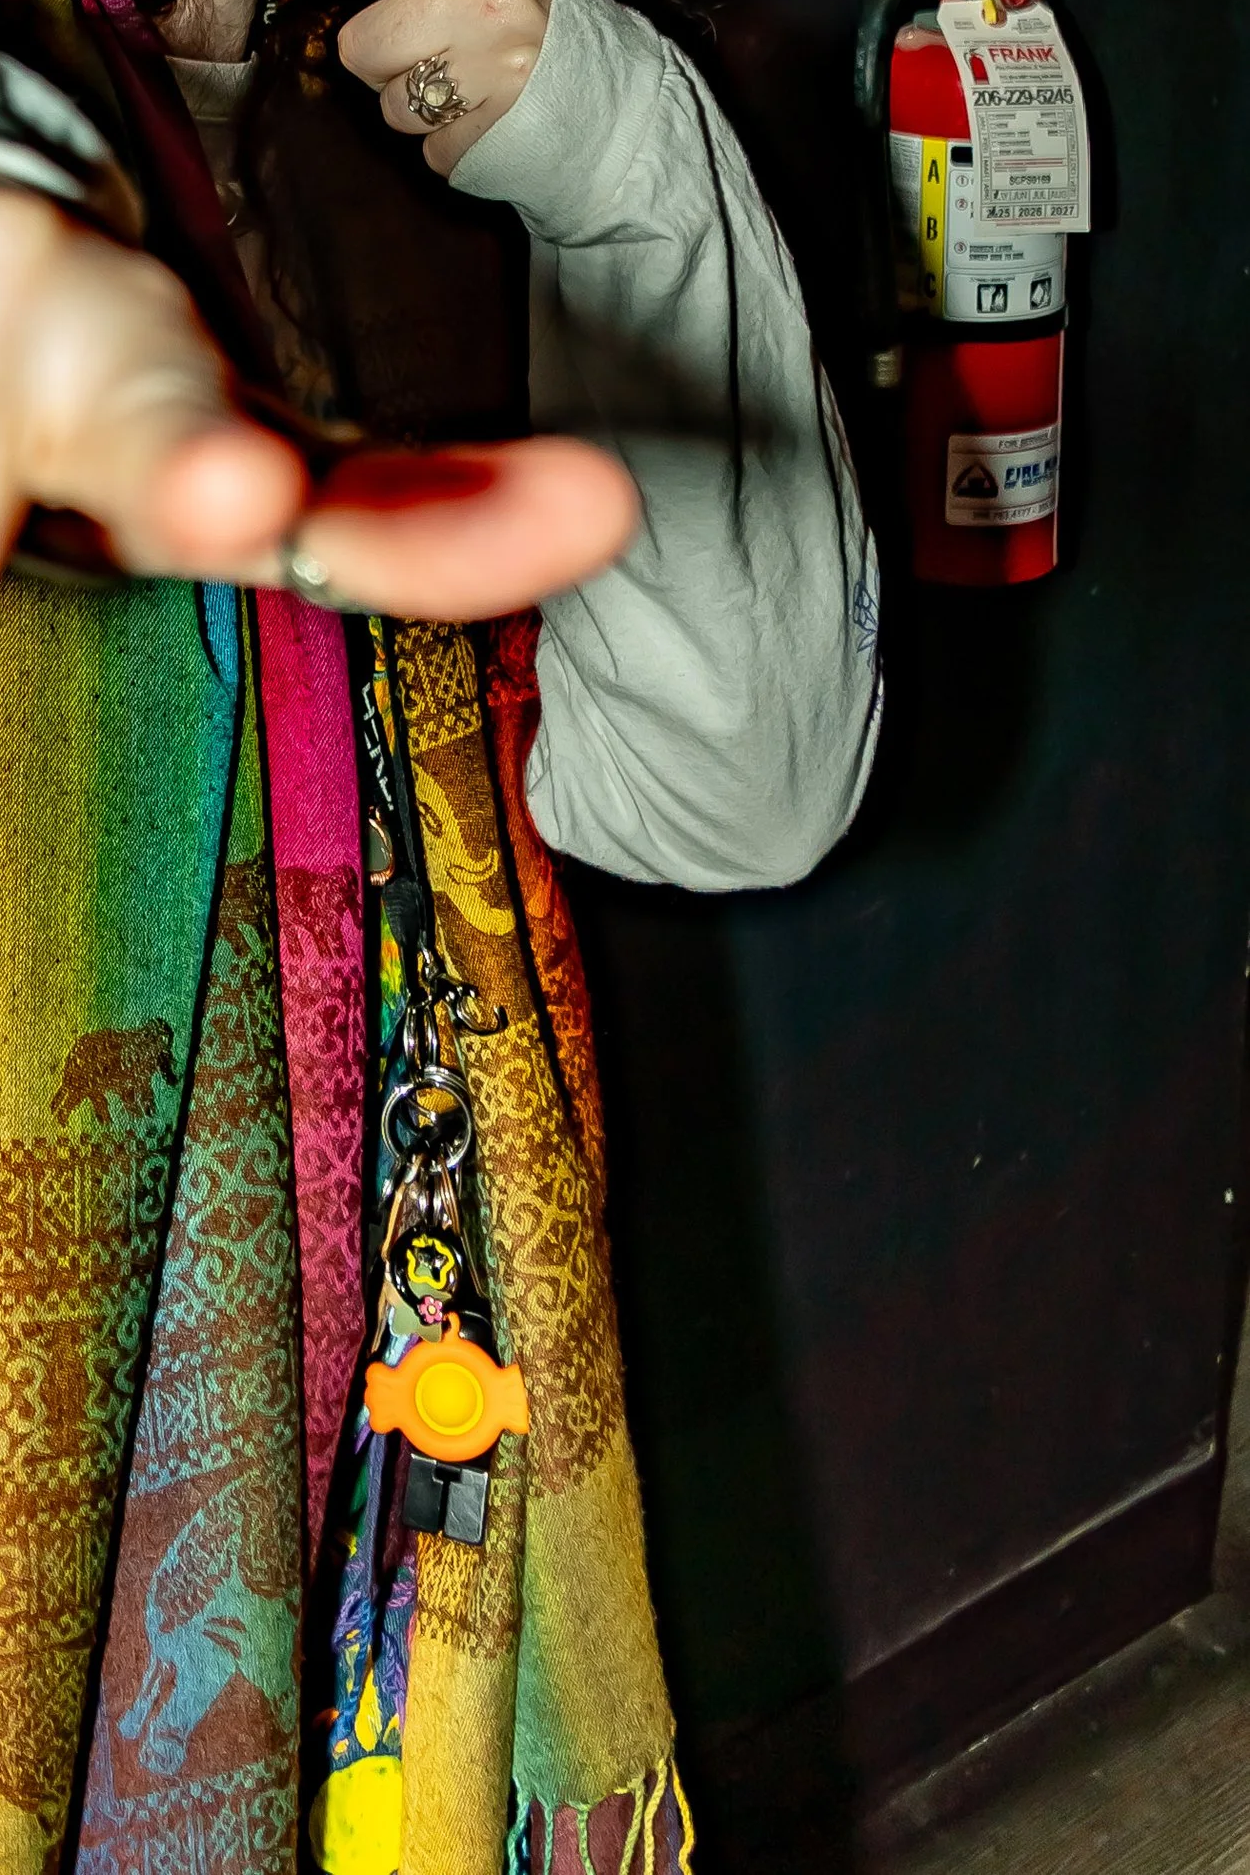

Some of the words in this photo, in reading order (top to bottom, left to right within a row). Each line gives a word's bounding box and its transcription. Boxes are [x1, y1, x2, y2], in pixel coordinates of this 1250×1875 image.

[988, 46, 1059, 63] FRANK
[973, 88, 1075, 106] 206-229-5245
[928, 158, 940, 185] A
[1018, 206, 1043, 218] 2026
[1050, 206, 1075, 217] 2027
[927, 216, 939, 241] B
[924, 273, 937, 298] C
[1005, 463, 1041, 482] FIRE
